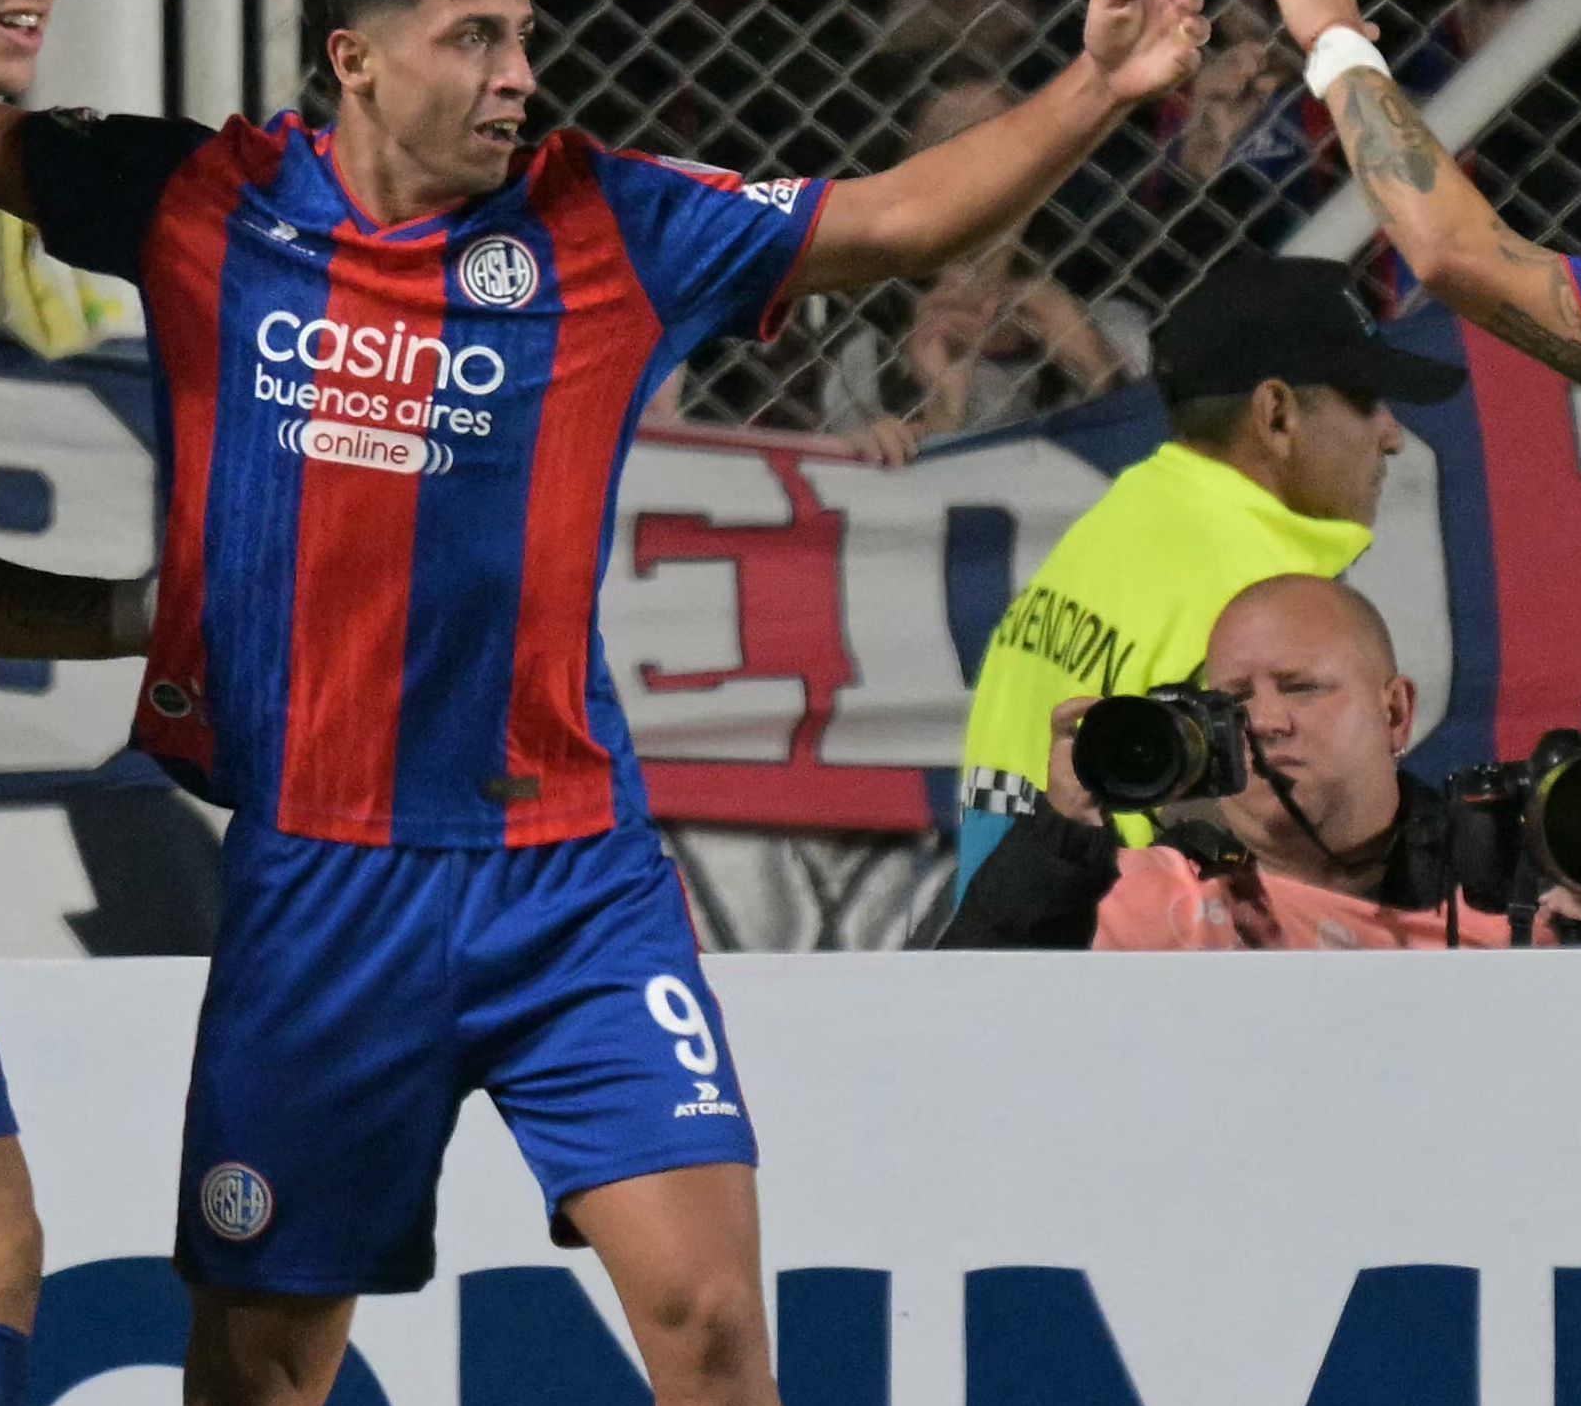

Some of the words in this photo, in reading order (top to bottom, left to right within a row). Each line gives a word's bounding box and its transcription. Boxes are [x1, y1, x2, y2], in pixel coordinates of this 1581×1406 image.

[256, 310, 506, 395] casino
[254, 363, 389, 421] buenos
[394, 394, 493, 437] aires
[312, 429, 411, 465] online
[645, 974, 719, 1076] 9
